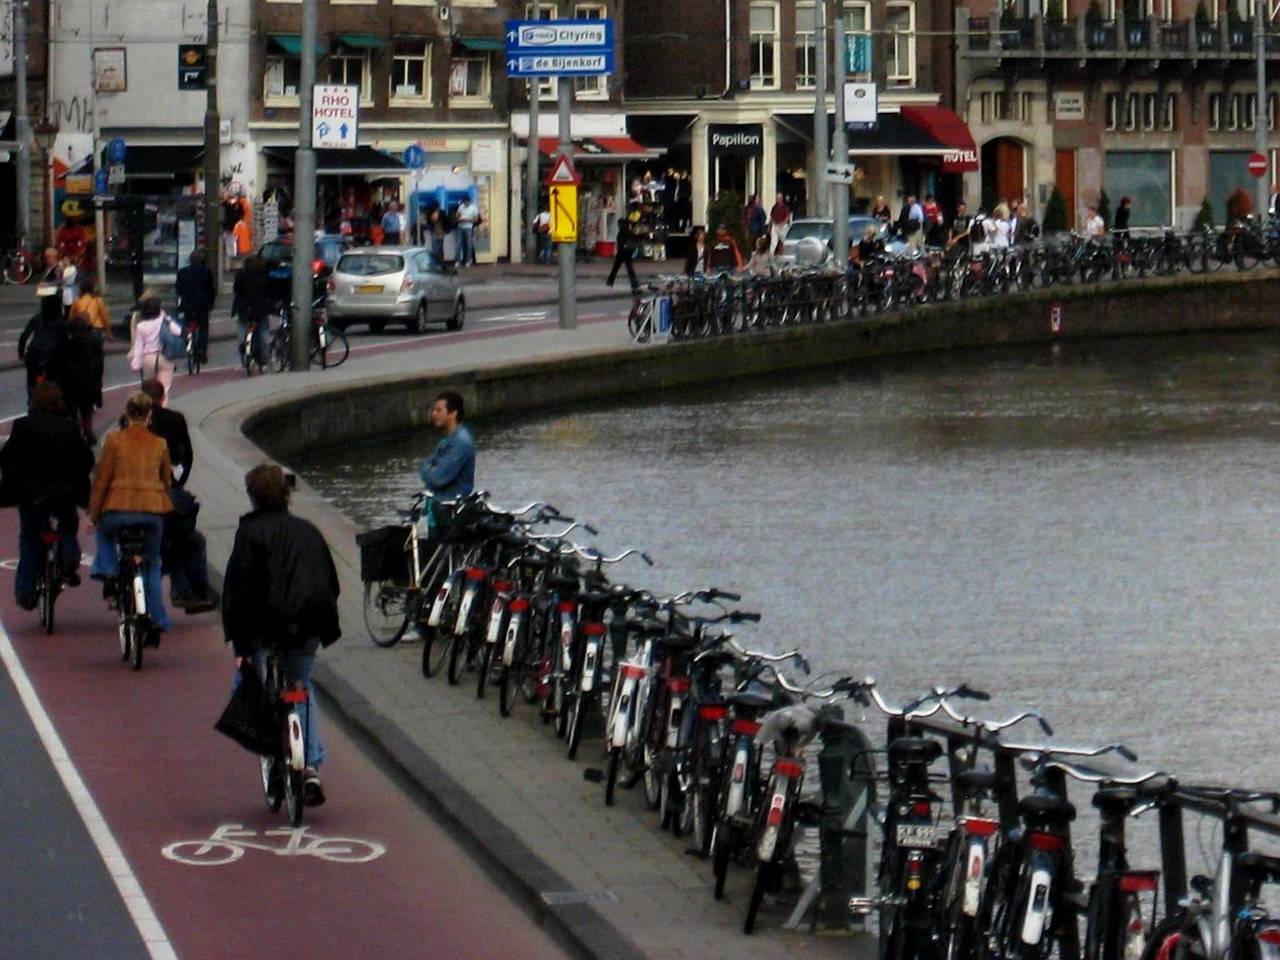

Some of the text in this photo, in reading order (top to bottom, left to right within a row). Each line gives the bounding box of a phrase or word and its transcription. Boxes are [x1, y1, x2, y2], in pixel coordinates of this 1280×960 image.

[560, 28, 602, 43] Cityring
[536, 57, 602, 70] de Bijenkorf
[322, 96, 349, 106] RHO
[315, 108, 354, 118] HOTEL
[712, 133, 760, 148] Papillon
[943, 150, 977, 163] HOTEL
